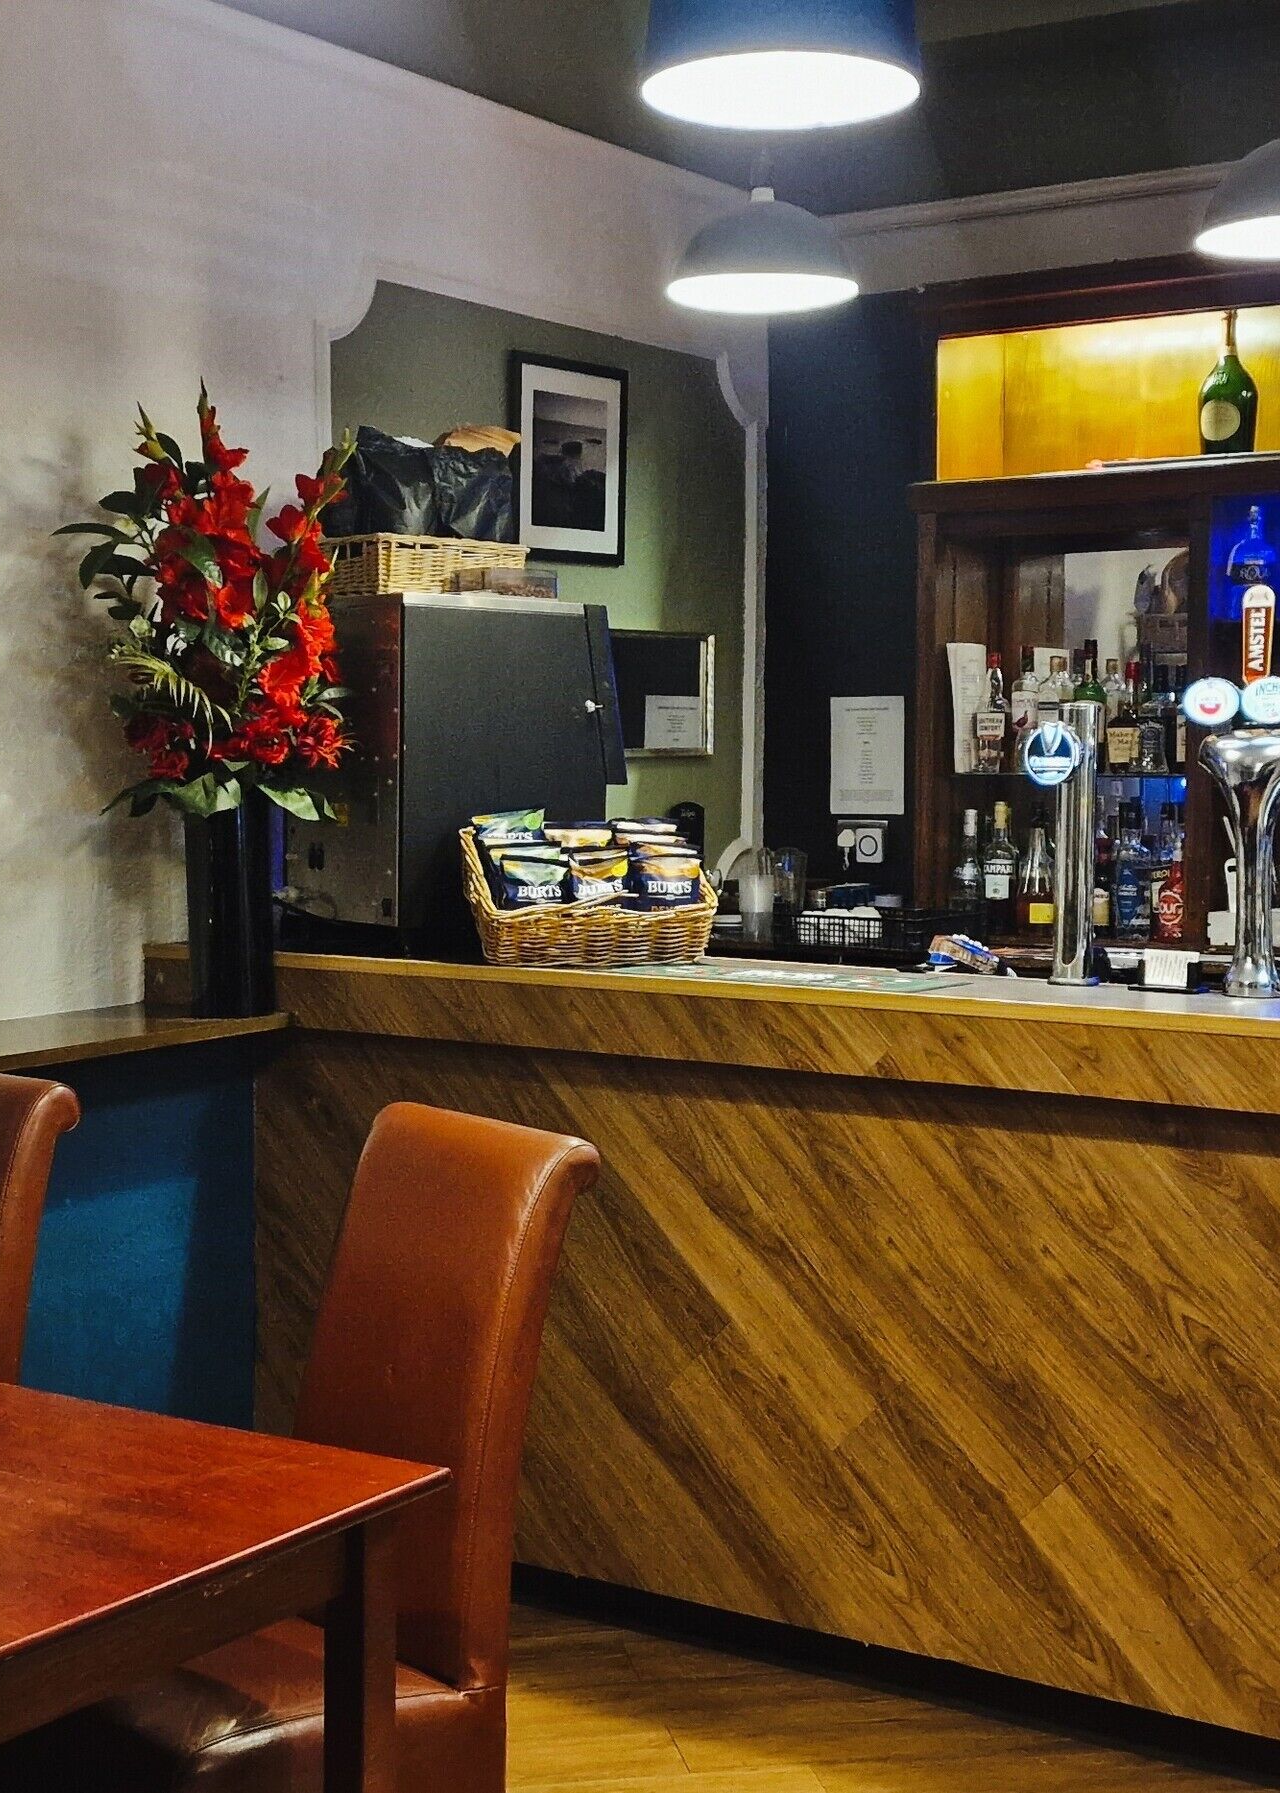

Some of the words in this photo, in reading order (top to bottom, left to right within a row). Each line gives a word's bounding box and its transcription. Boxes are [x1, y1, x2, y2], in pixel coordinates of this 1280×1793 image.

[1247, 607, 1266, 672] AMSTEL
[517, 885, 562, 898] BURTS
[646, 880, 693, 896] BURTS
